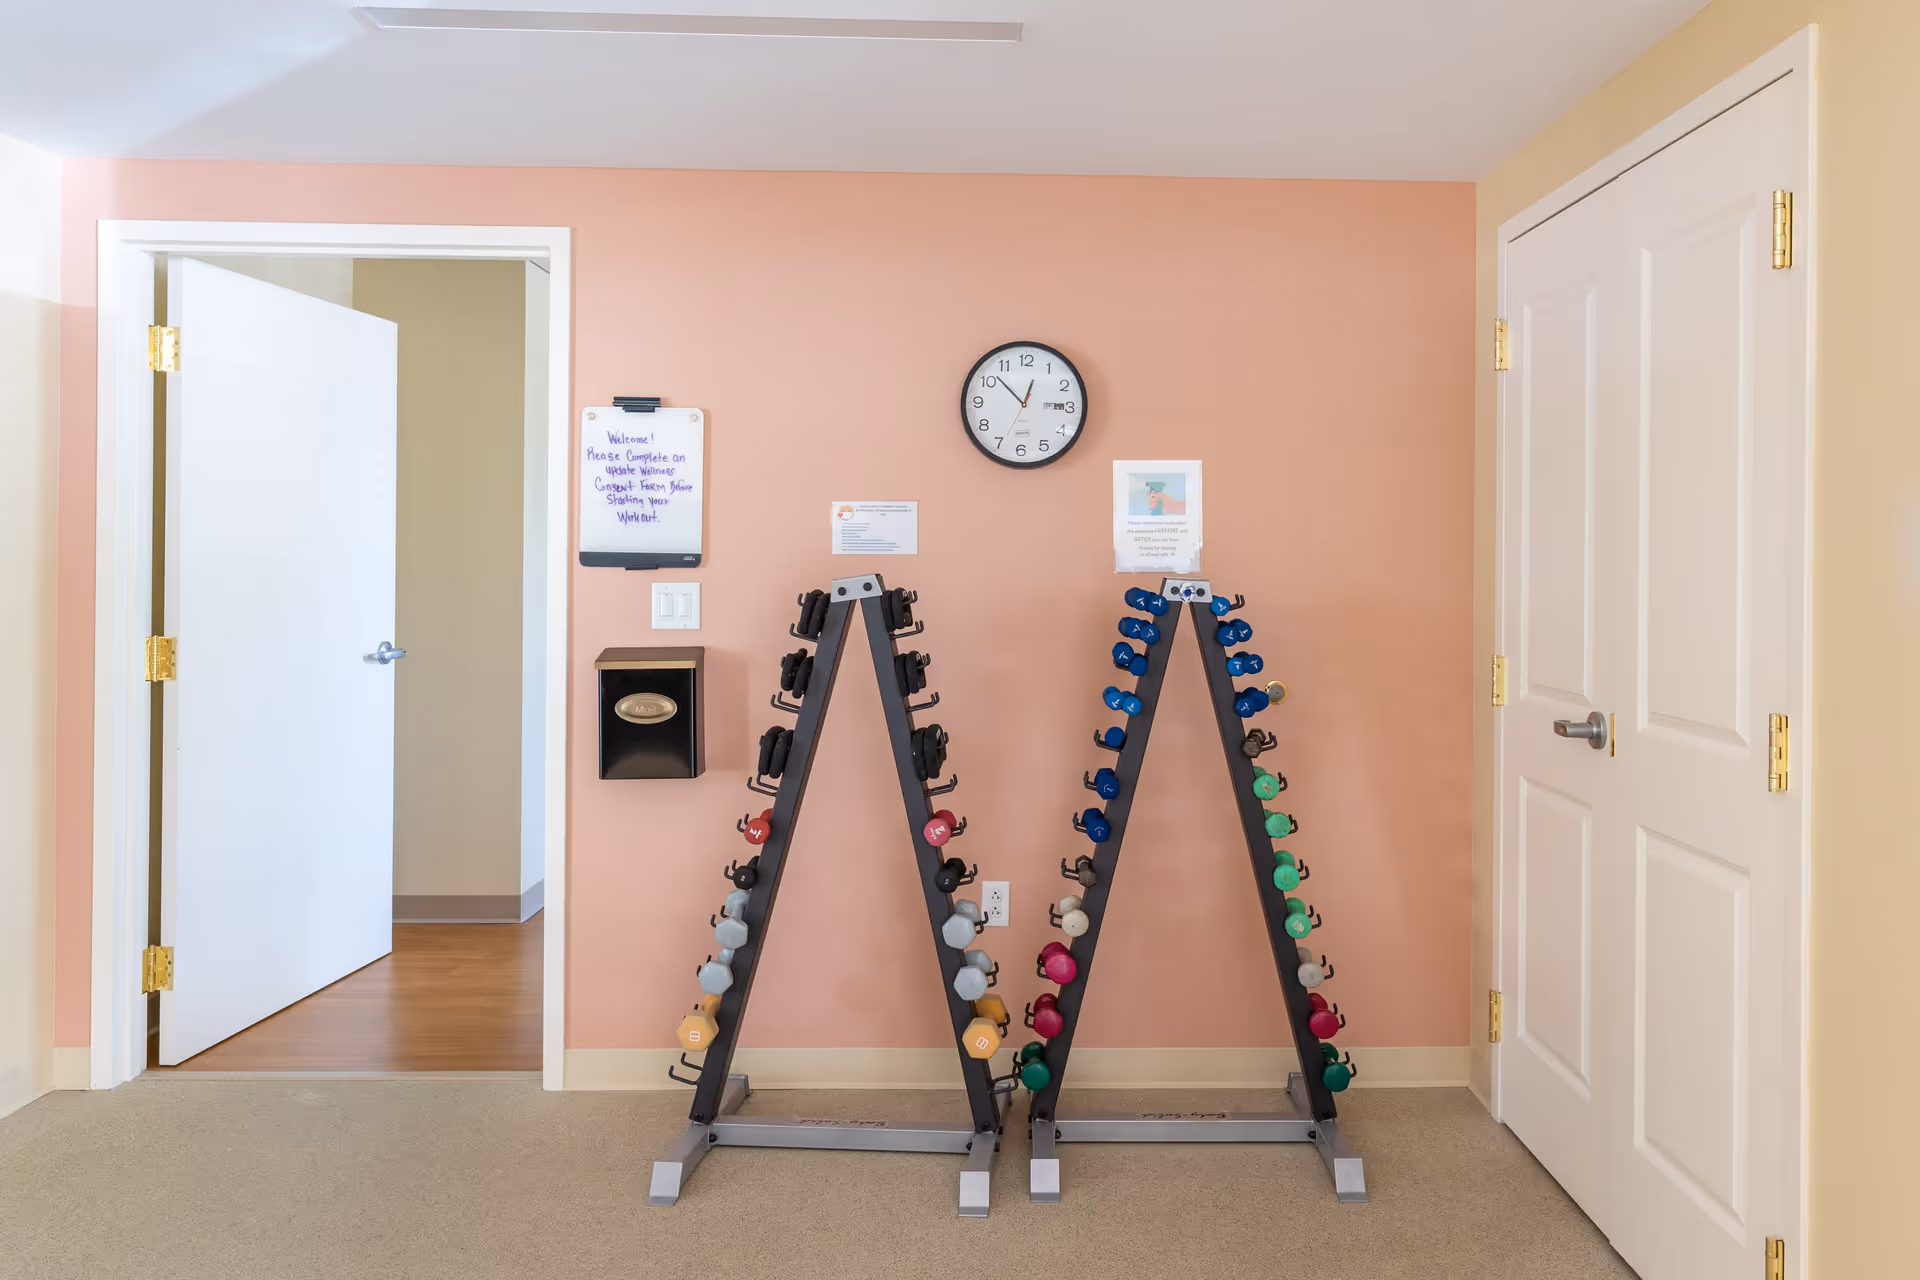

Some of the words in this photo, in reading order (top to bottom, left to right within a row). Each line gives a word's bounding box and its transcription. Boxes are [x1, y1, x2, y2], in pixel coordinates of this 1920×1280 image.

[998, 359, 1010, 372] 11
[1019, 354, 1034, 367] 12
[1046, 362, 1051, 375] 1
[981, 375, 997, 388] 10
[1060, 379, 1070, 392] 2
[973, 395, 984, 409] 9
[1064, 401, 1075, 414] 3
[979, 418, 989, 431] 8
[1056, 424, 1066, 437] 4
[607, 430, 654, 445] Welcome!
[994, 436, 1004, 449] 7
[1015, 444, 1027, 457] 6
[1038, 439, 1050, 452] 5
[587, 446, 620, 461] Please
[626, 449, 668, 465] Complete
[672, 454, 686, 463] an
[640, 465, 676, 476] Wellness
[594, 476, 636, 493] Consent
[606, 493, 644, 507] Starting
[935, 825, 946, 835] 2
